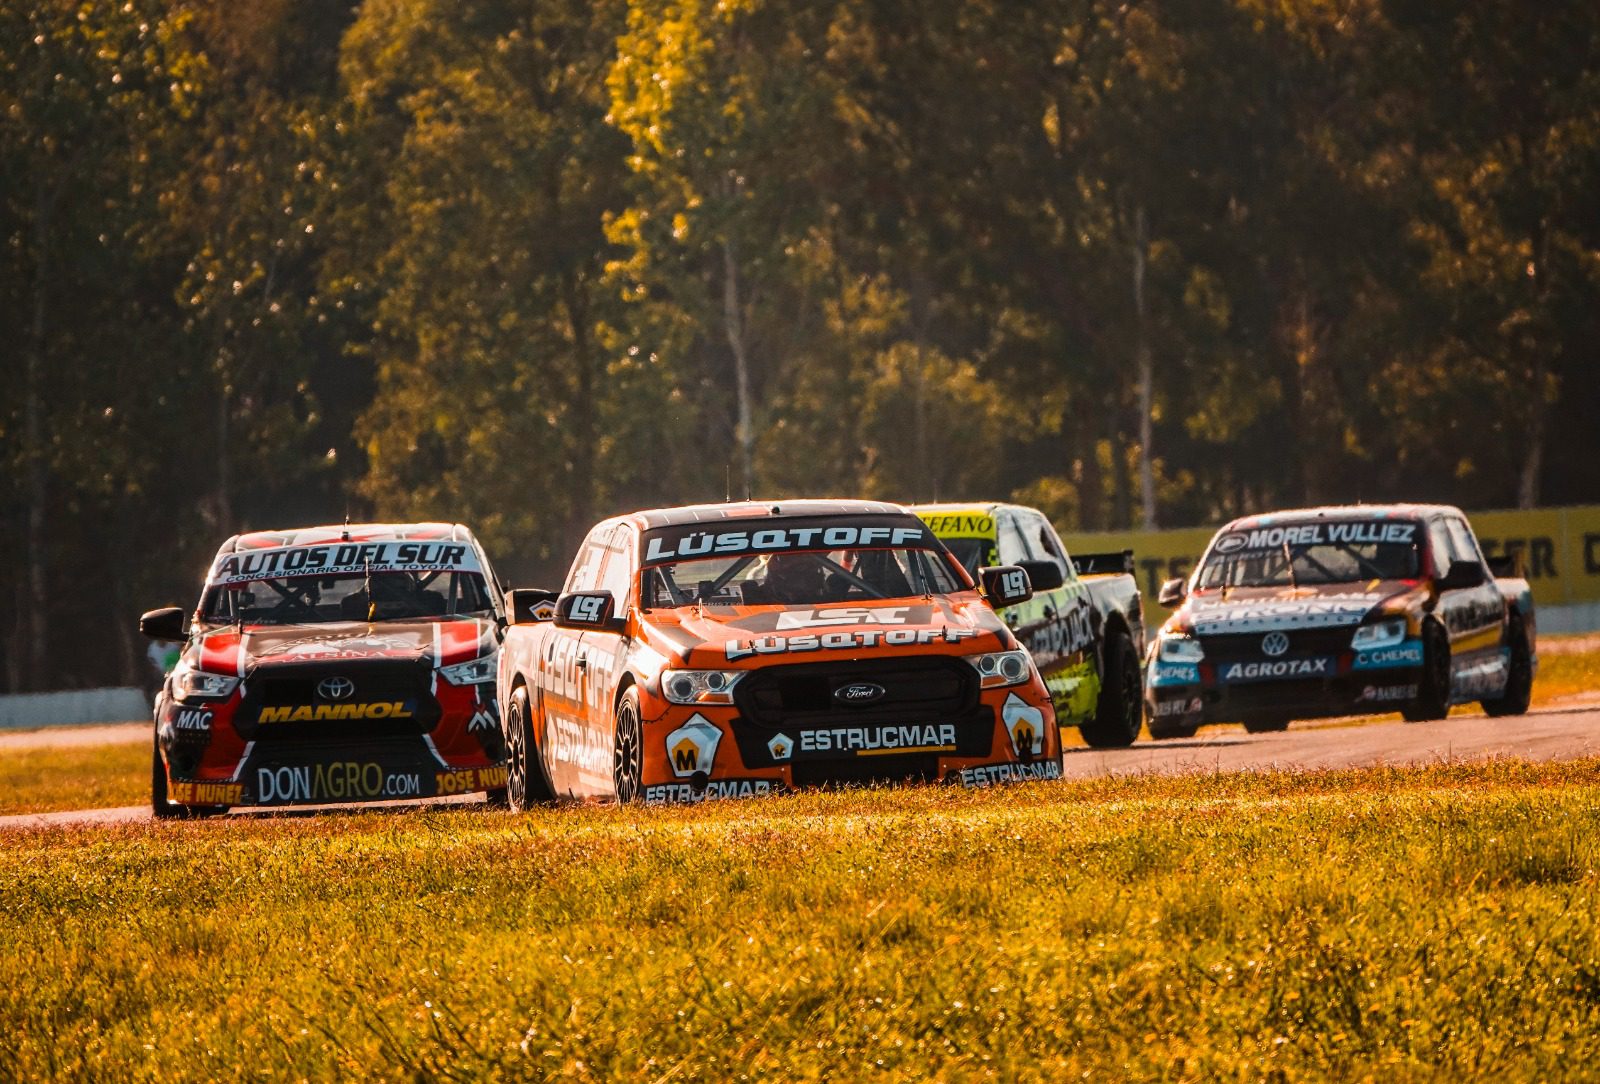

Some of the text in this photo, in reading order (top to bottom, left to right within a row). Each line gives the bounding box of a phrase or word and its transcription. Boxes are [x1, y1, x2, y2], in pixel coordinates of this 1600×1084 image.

[645, 527, 923, 561] LÜSQTOFF
[1249, 528, 1324, 549] MOREL
[1328, 524, 1416, 543] VULLIEZ
[220, 543, 466, 579] AUTOS DEL SUR
[225, 566, 340, 583] CONCESIONARIO
[400, 561, 455, 571] TOYOTA
[1225, 658, 1328, 680] AGROTAX
[176, 710, 213, 731] MAC
[258, 702, 413, 724] MANNOL
[800, 723, 957, 751] ESTRUCMAR
[675, 749, 697, 772] M
[435, 770, 474, 795] JOSE
